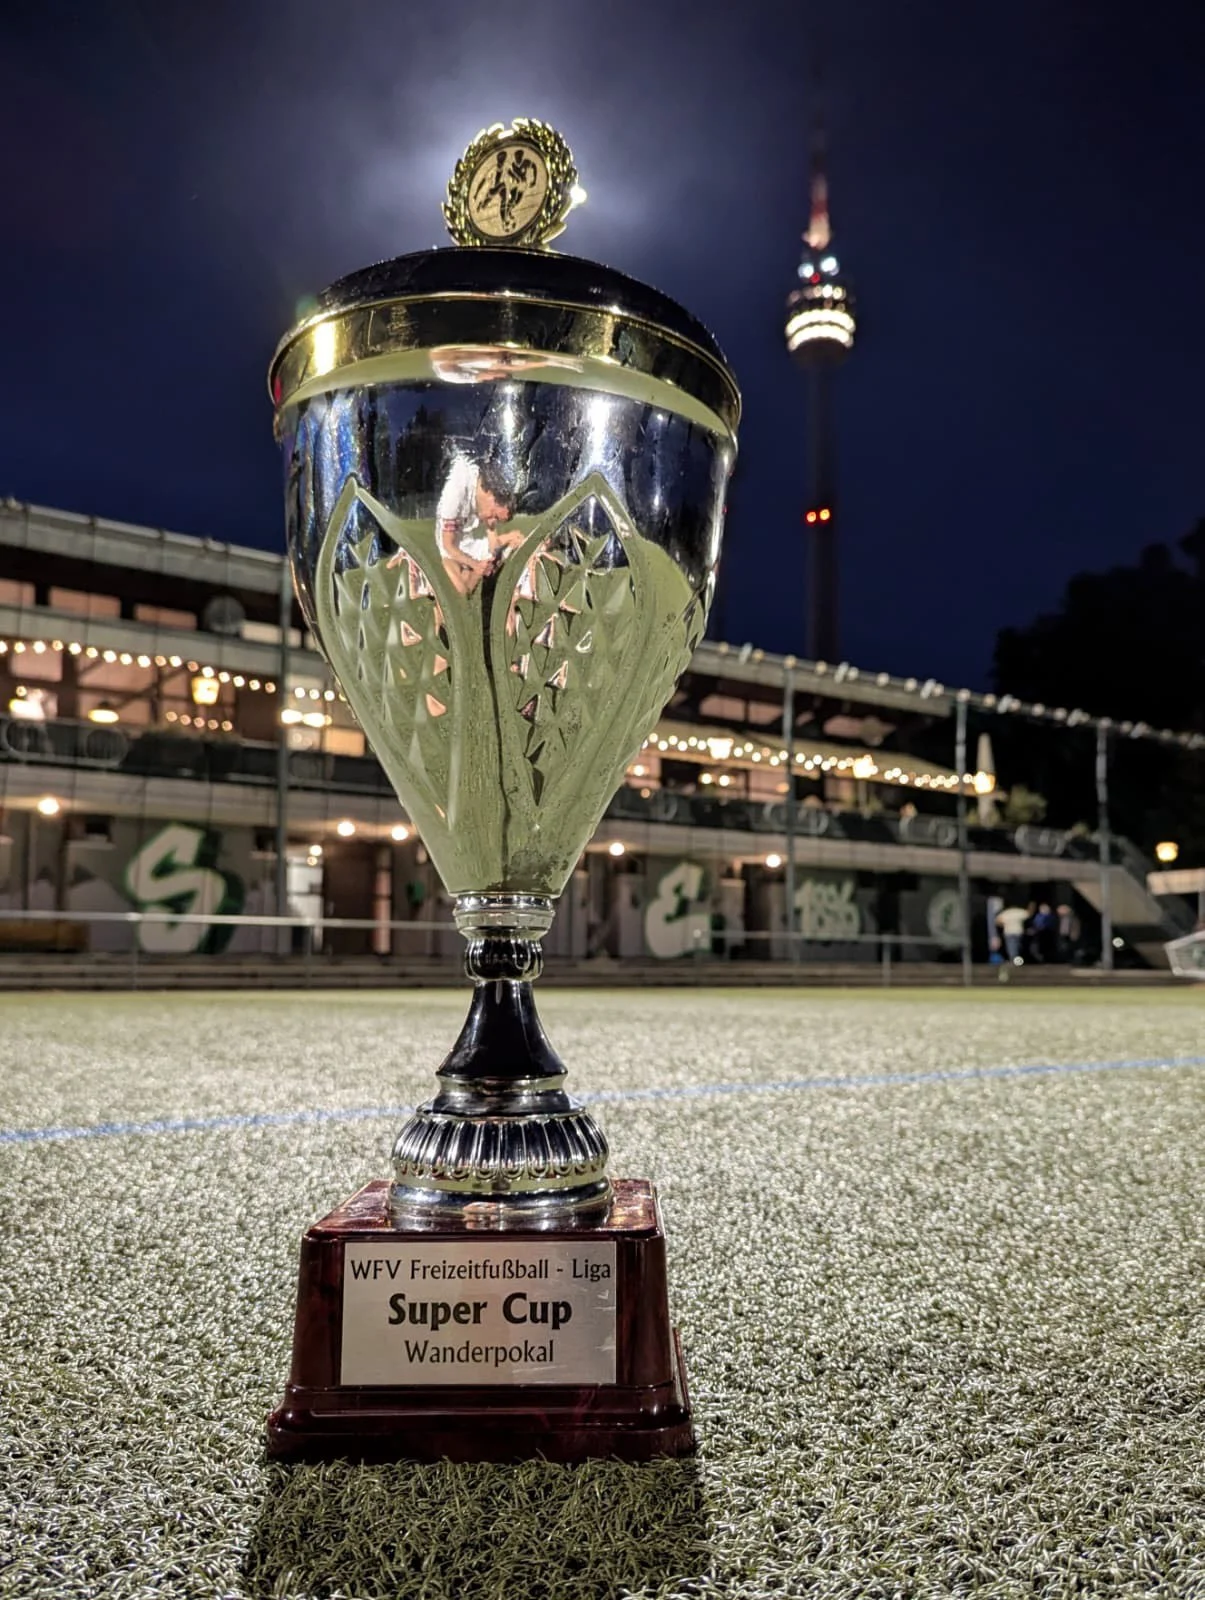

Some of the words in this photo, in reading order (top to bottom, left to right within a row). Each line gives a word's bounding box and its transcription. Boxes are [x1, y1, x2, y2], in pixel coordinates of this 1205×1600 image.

[350, 1259, 402, 1280] WFV
[410, 1258, 549, 1280] Freizeitfußball
[572, 1258, 612, 1282] Liga
[388, 1292, 488, 1331] Super
[502, 1291, 573, 1330] Cup
[404, 1339, 554, 1368] Wanderpokal
